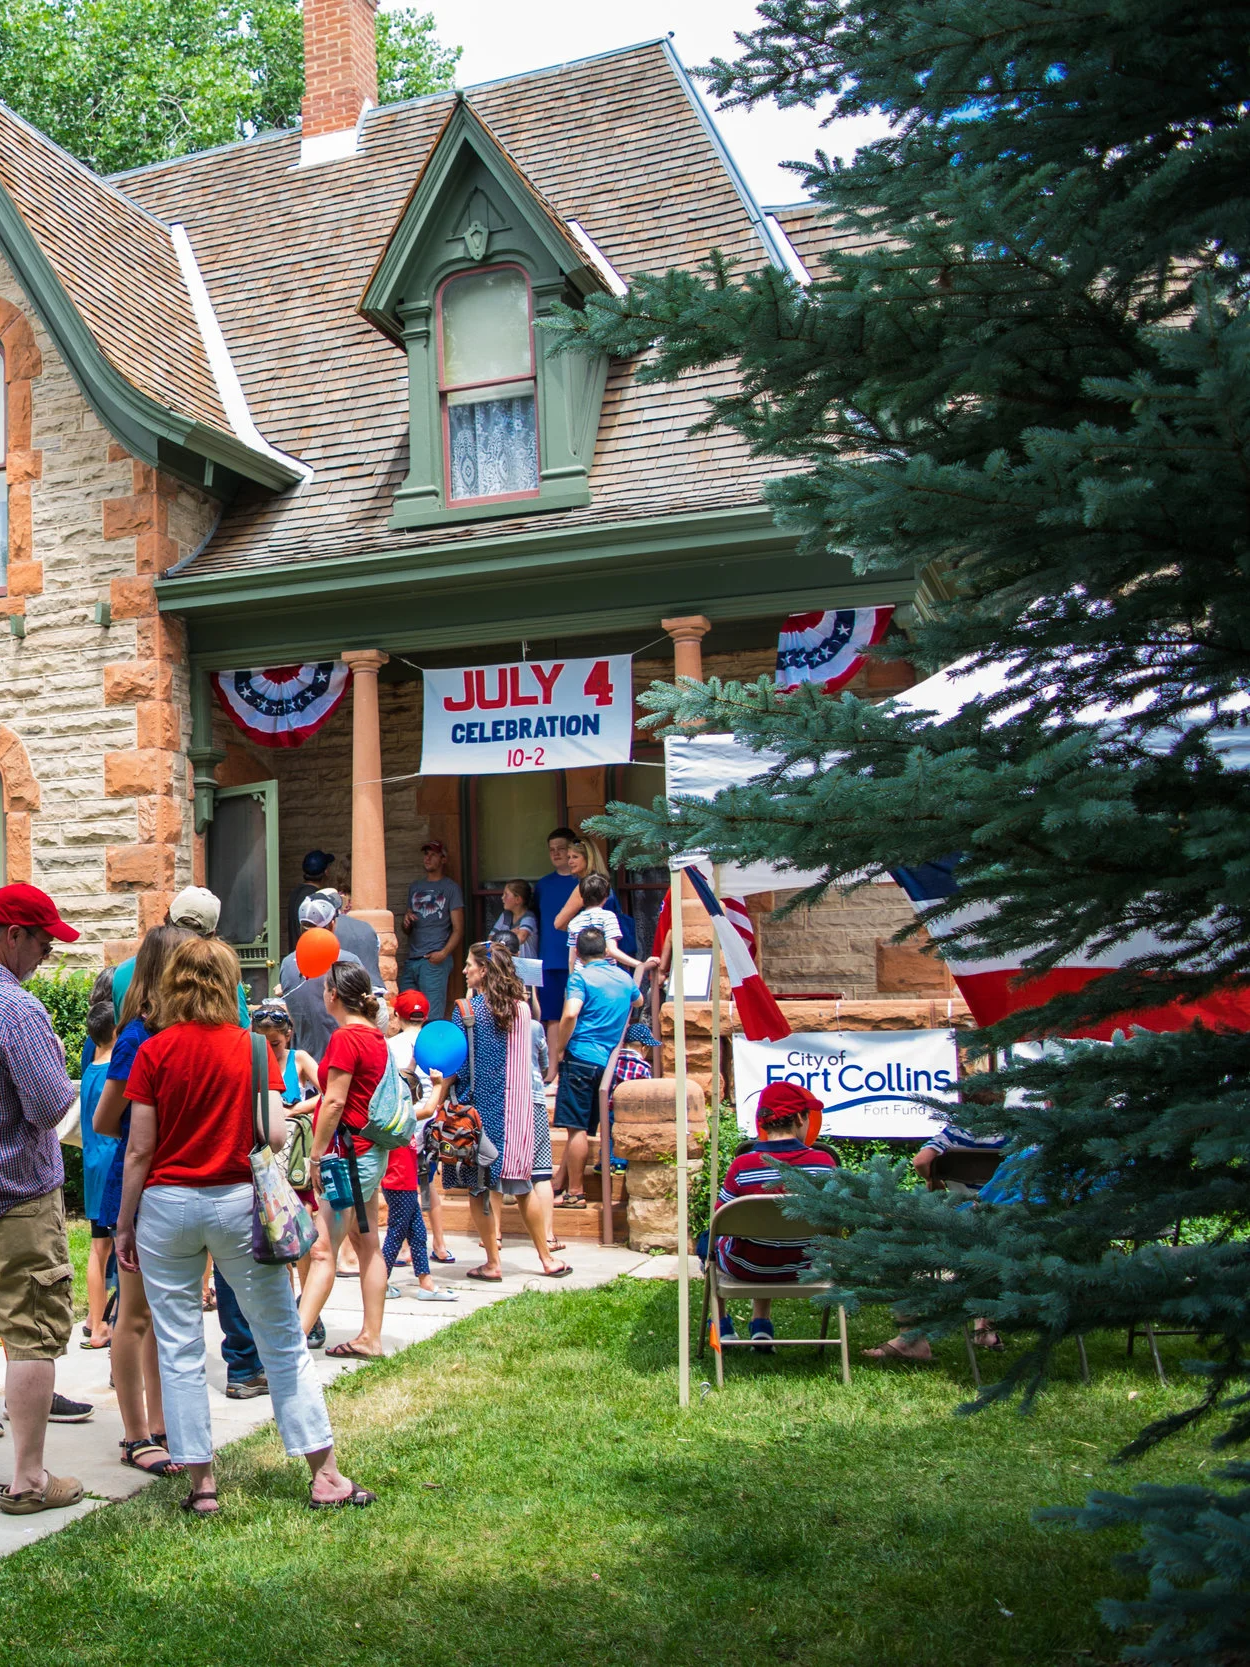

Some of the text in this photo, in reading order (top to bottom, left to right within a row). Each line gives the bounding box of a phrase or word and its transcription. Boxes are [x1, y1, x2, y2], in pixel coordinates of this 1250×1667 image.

[443, 660, 614, 712] JULY 4
[451, 713, 600, 744] CELEBRATION
[507, 747, 545, 767] 10-2
[787, 1050, 846, 1070] City of
[766, 1063, 951, 1092] Fort Collins
[864, 1104, 926, 1115] Fort Fund
